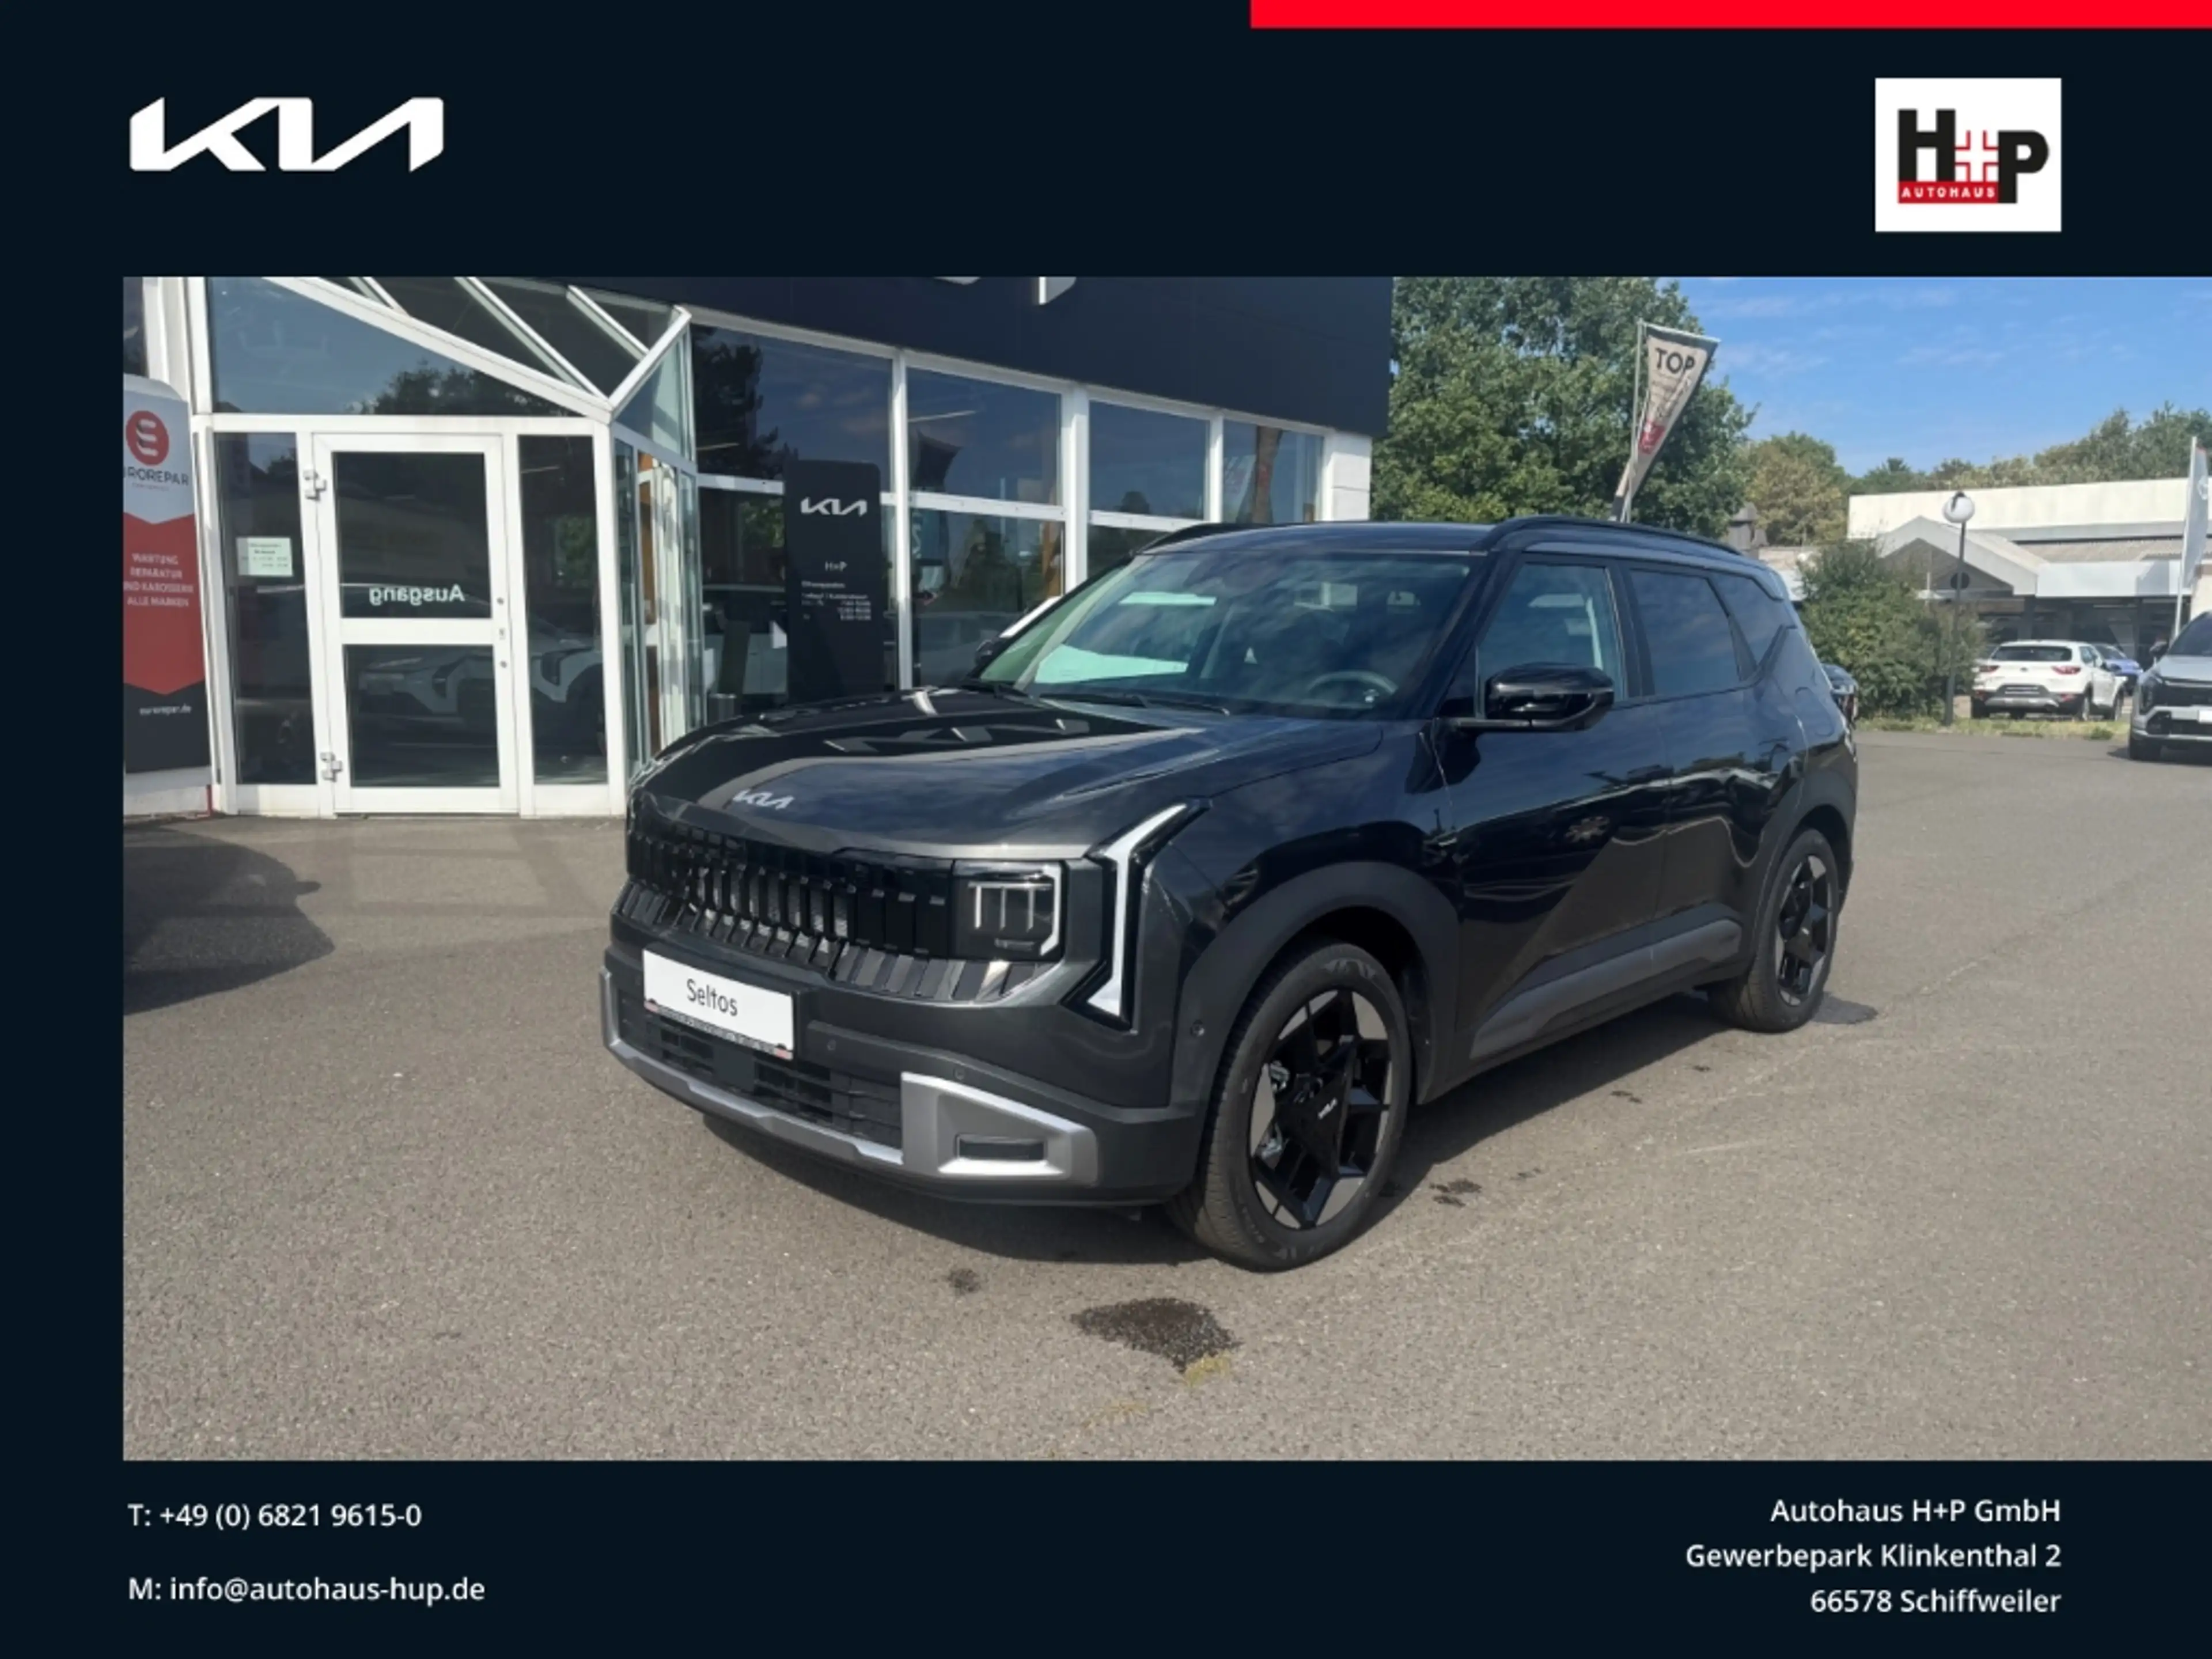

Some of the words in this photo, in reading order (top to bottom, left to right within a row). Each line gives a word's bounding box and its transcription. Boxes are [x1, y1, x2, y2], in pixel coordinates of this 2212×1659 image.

[1656, 347, 1695, 374] TOP
[800, 496, 868, 517] KIA
[733, 789, 794, 810] KIA
[687, 978, 738, 1017] Seltos
